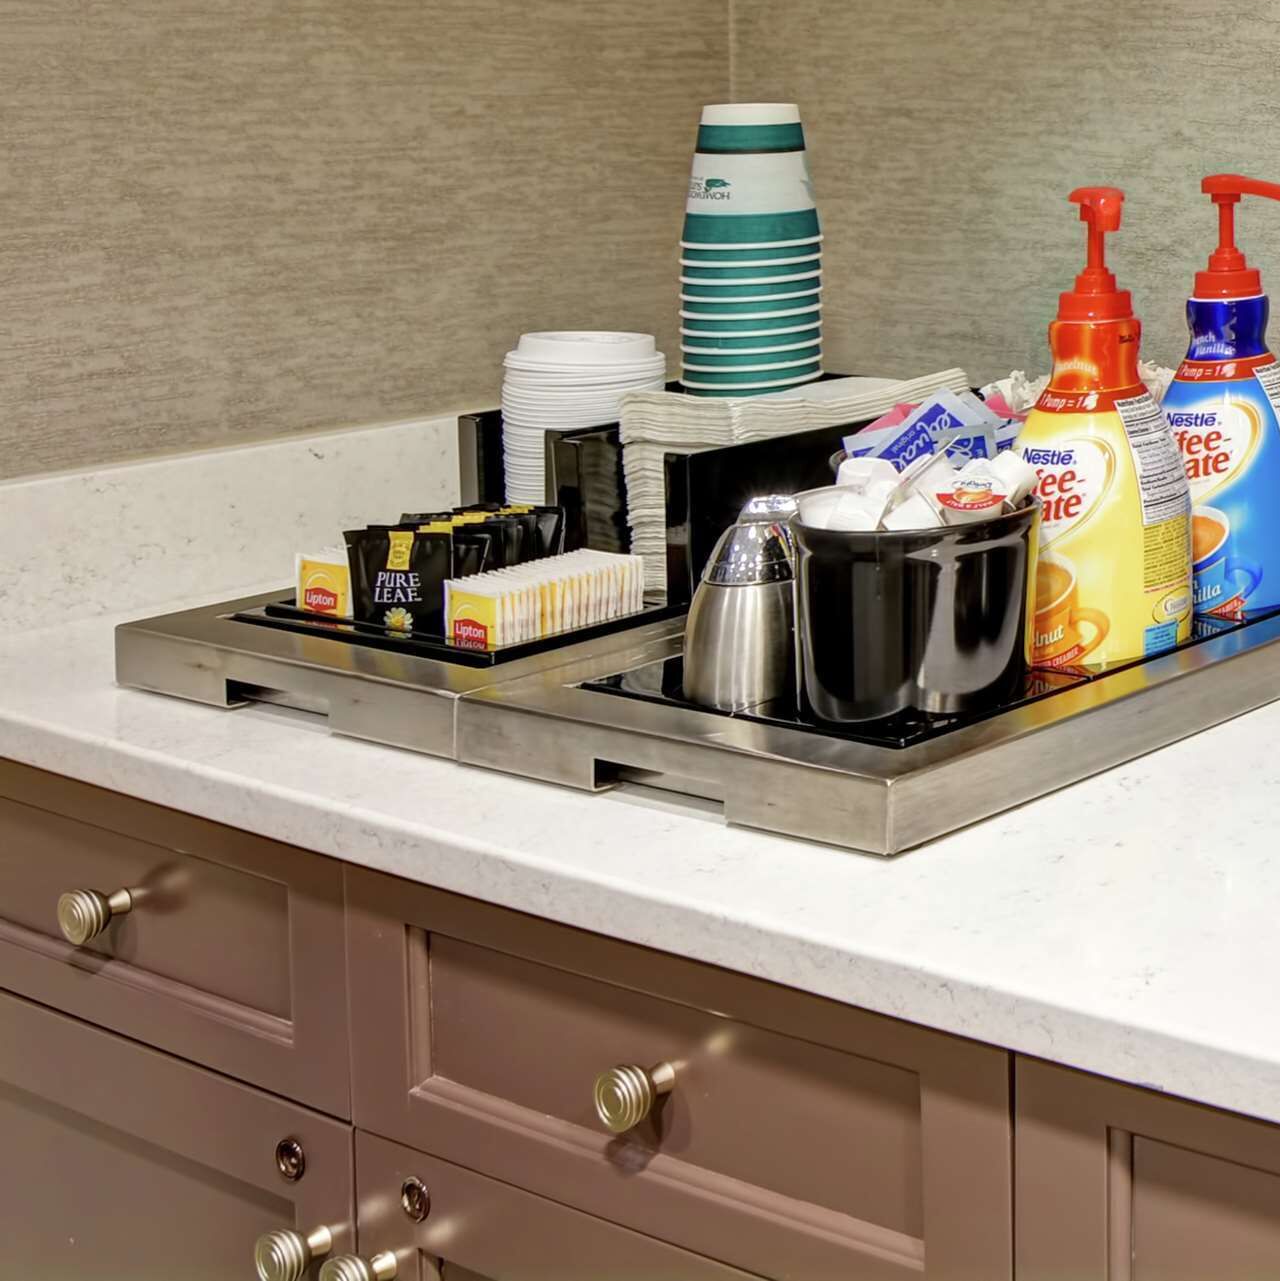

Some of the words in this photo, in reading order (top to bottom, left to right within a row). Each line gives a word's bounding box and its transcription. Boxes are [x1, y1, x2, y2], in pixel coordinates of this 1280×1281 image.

[1045, 395, 1066, 411] Pump
[375, 572, 422, 588] PURE
[305, 591, 335, 607] Lipton
[374, 588, 417, 603] LEAF
[455, 622, 485, 639] Lipton
